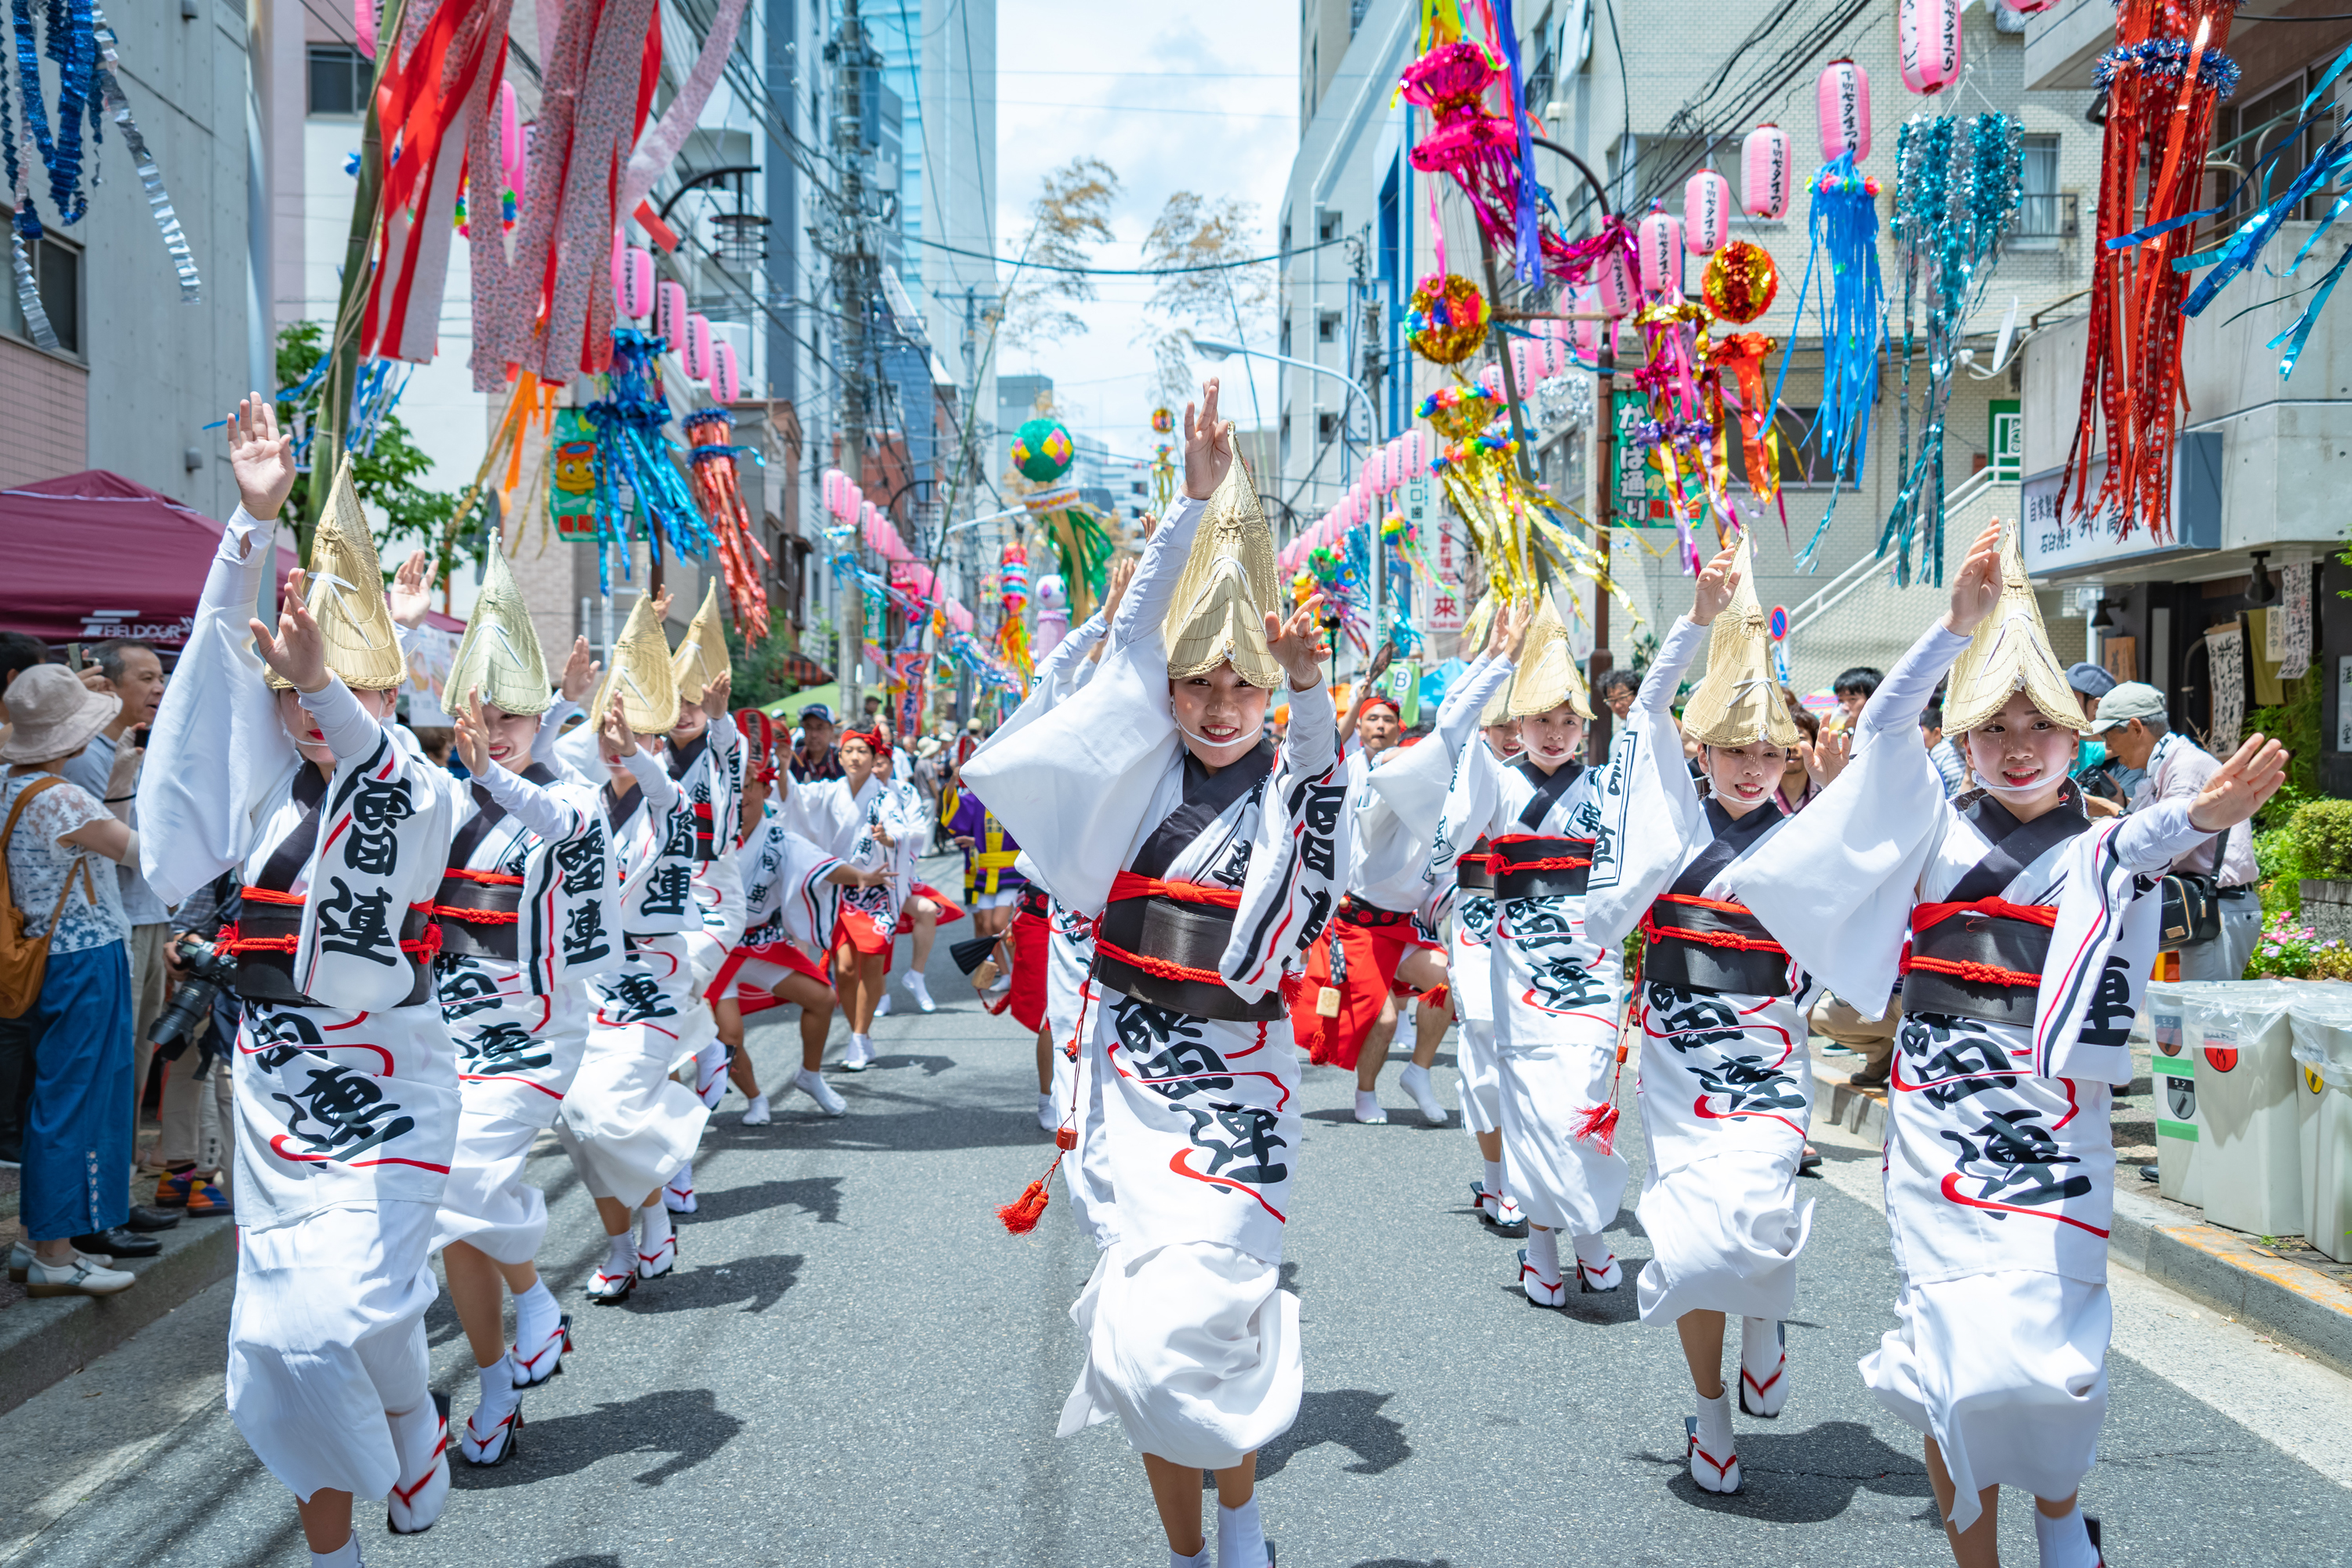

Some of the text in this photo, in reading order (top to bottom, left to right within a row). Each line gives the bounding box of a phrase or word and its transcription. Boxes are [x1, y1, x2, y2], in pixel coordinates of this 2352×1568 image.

[1842, 71, 1858, 151] 下町七夕まつり
[1770, 139, 1784, 213] 下町七夕まつり
[1704, 181, 1716, 249] 下町七夕まつり
[1649, 499, 1702, 518] 商会
[1395, 672, 1407, 688] B
